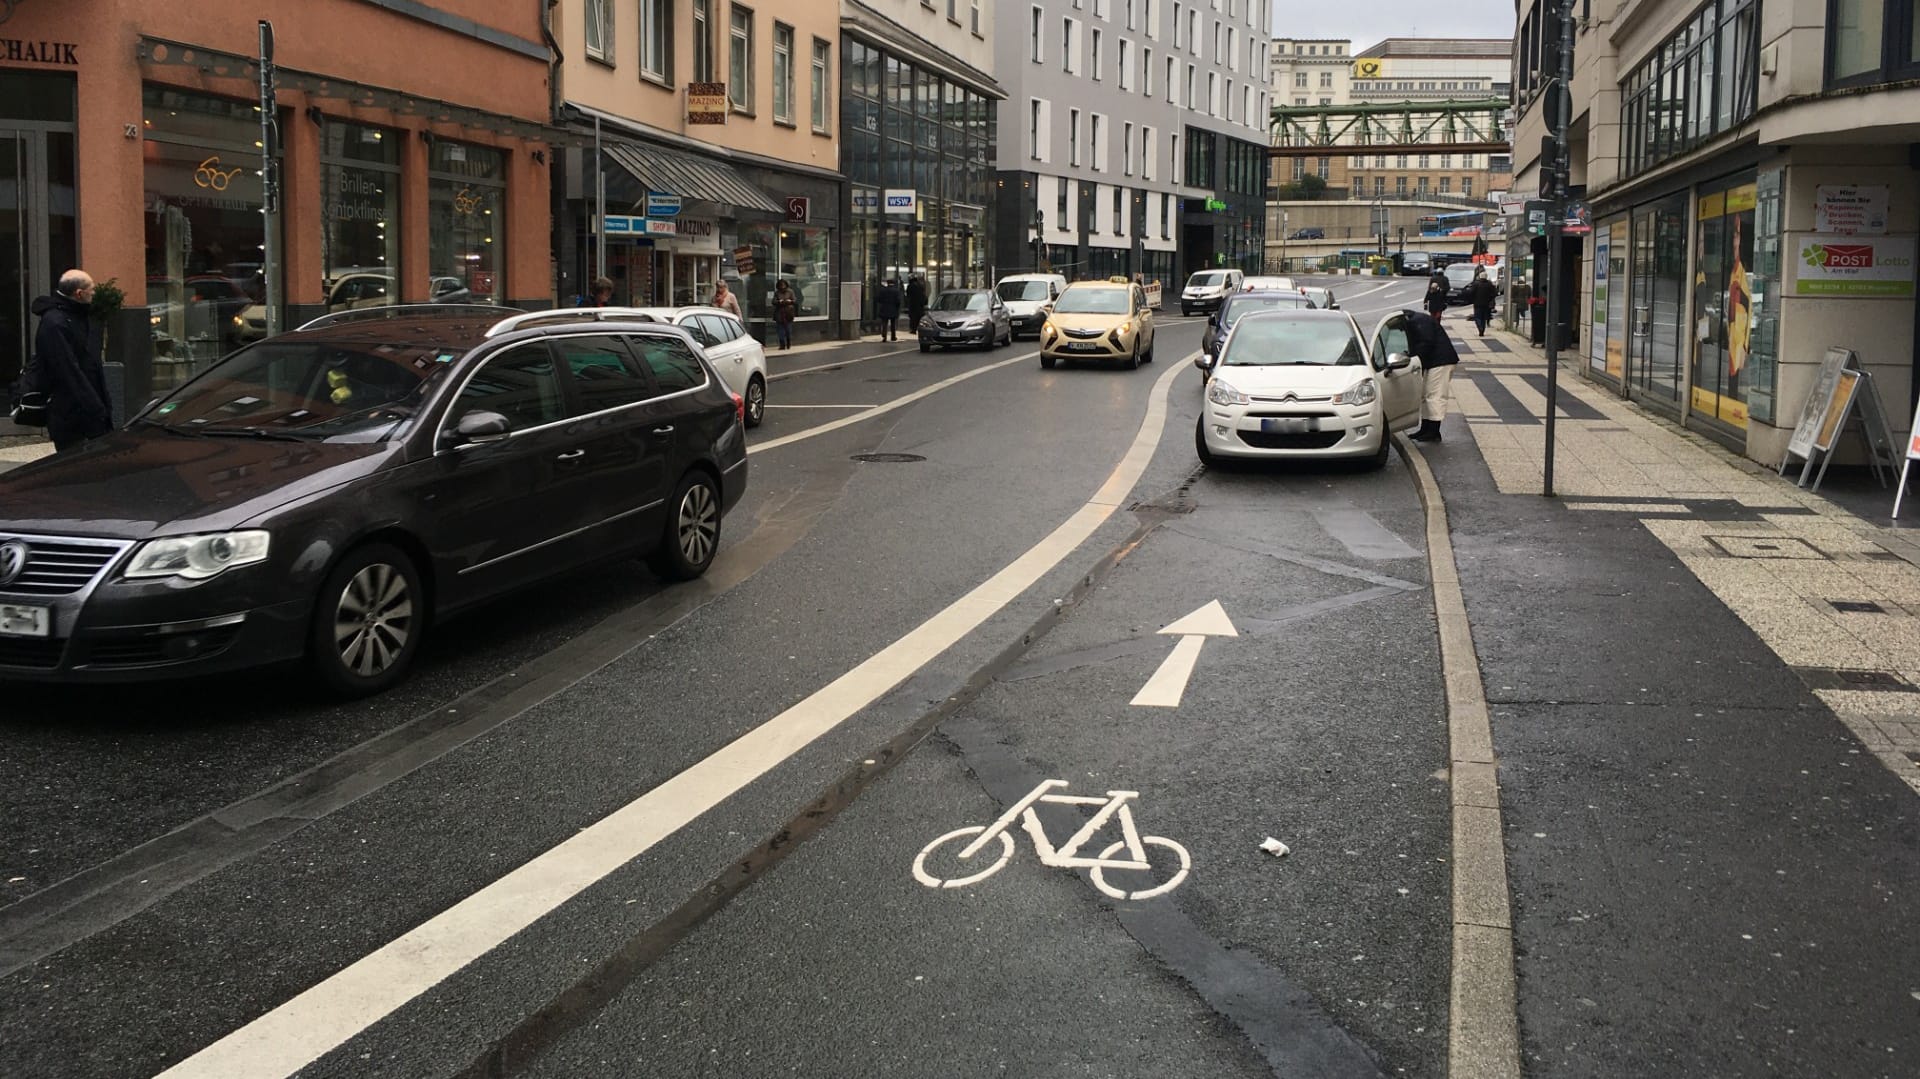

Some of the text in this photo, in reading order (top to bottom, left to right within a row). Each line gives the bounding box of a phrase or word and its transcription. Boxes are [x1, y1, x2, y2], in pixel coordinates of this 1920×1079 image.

[689, 97, 725, 105] MAZZINO
[125, 123, 137, 137] 23
[888, 197, 909, 206] WSW
[676, 219, 711, 237] MAZZINO
[1831, 255, 1910, 267] POST Lotto
